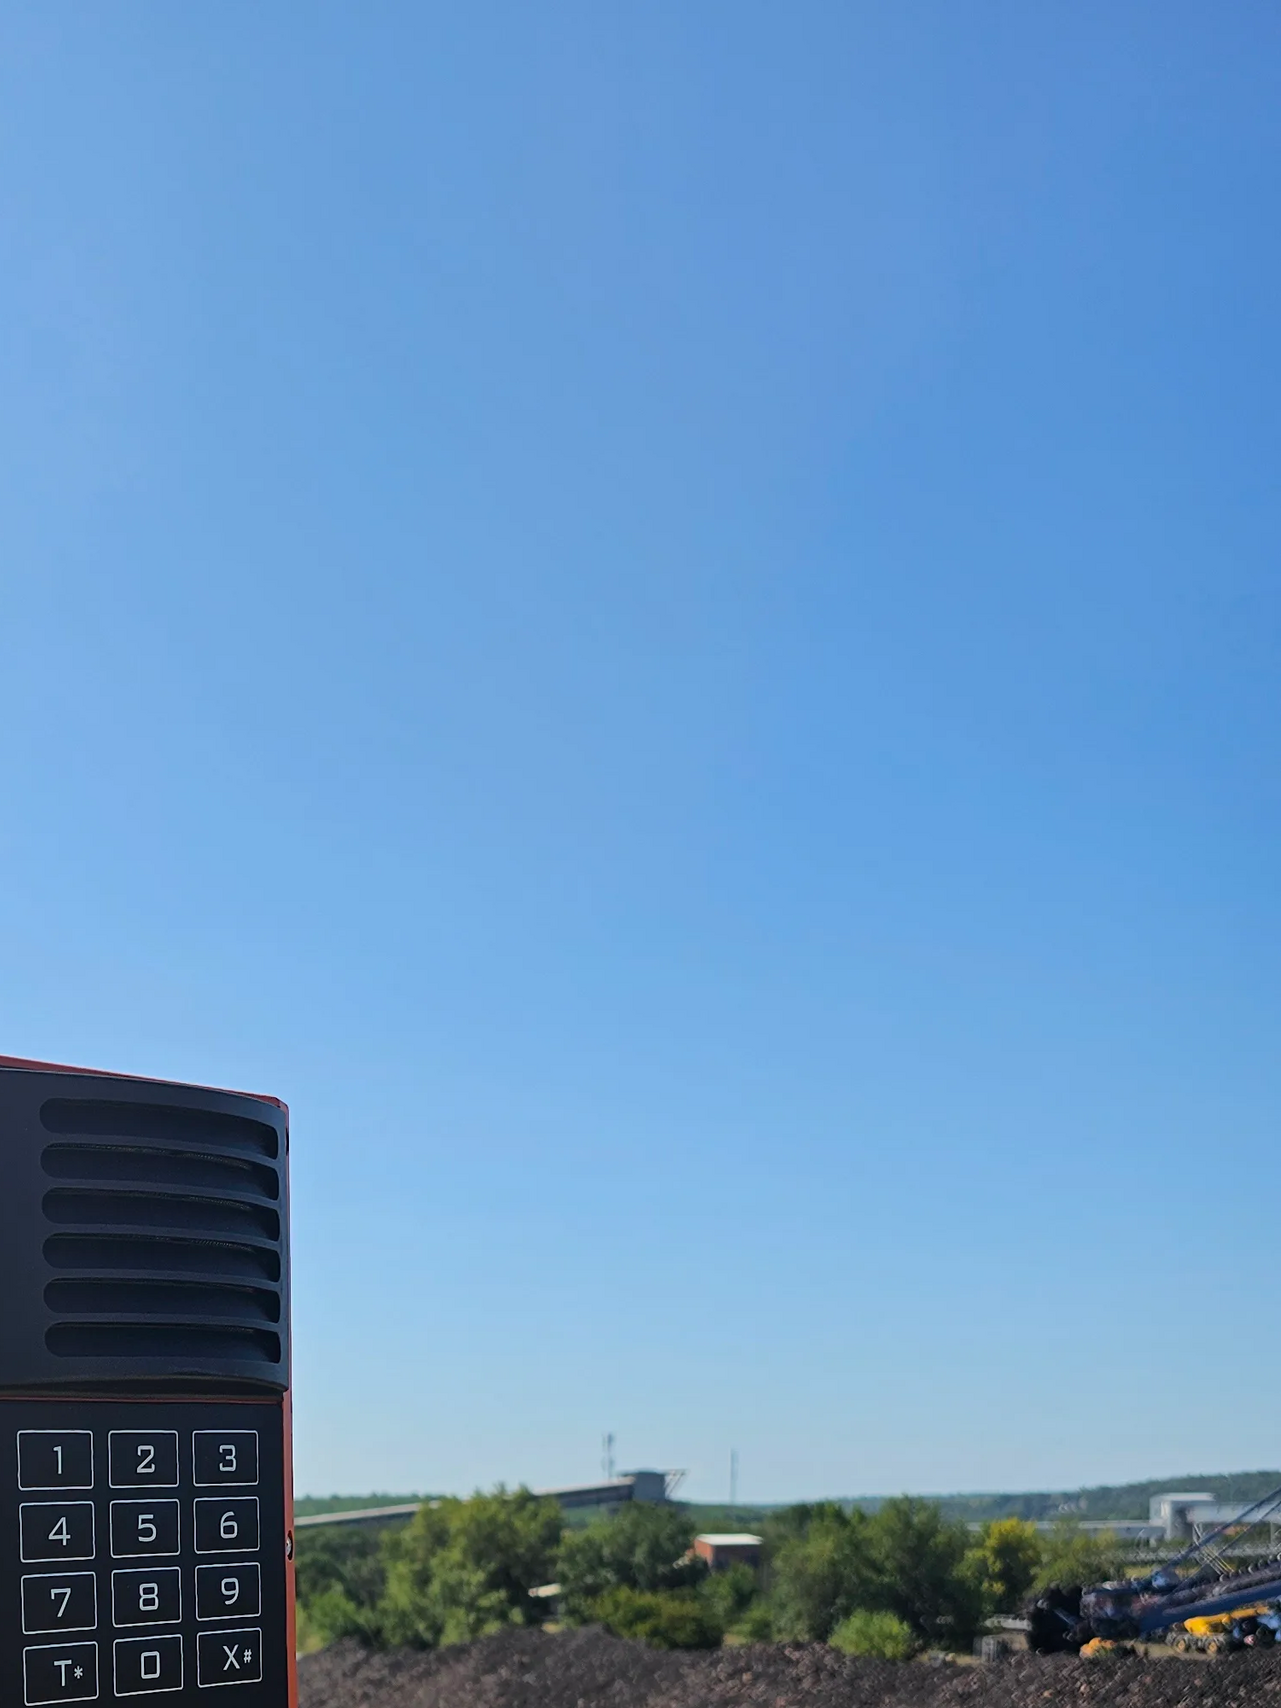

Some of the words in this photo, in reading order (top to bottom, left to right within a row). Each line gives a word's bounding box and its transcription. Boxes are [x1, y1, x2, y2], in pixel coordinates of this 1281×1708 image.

[53, 1445, 62, 1475] 1
[136, 1444, 156, 1474] 2
[219, 1444, 237, 1472] 3
[48, 1516, 71, 1546] 4
[137, 1513, 157, 1543] 5
[220, 1511, 238, 1539] 6
[50, 1587, 72, 1618] 7
[139, 1582, 159, 1611] 8
[221, 1577, 240, 1605] 9
[140, 1650, 161, 1680] 0
